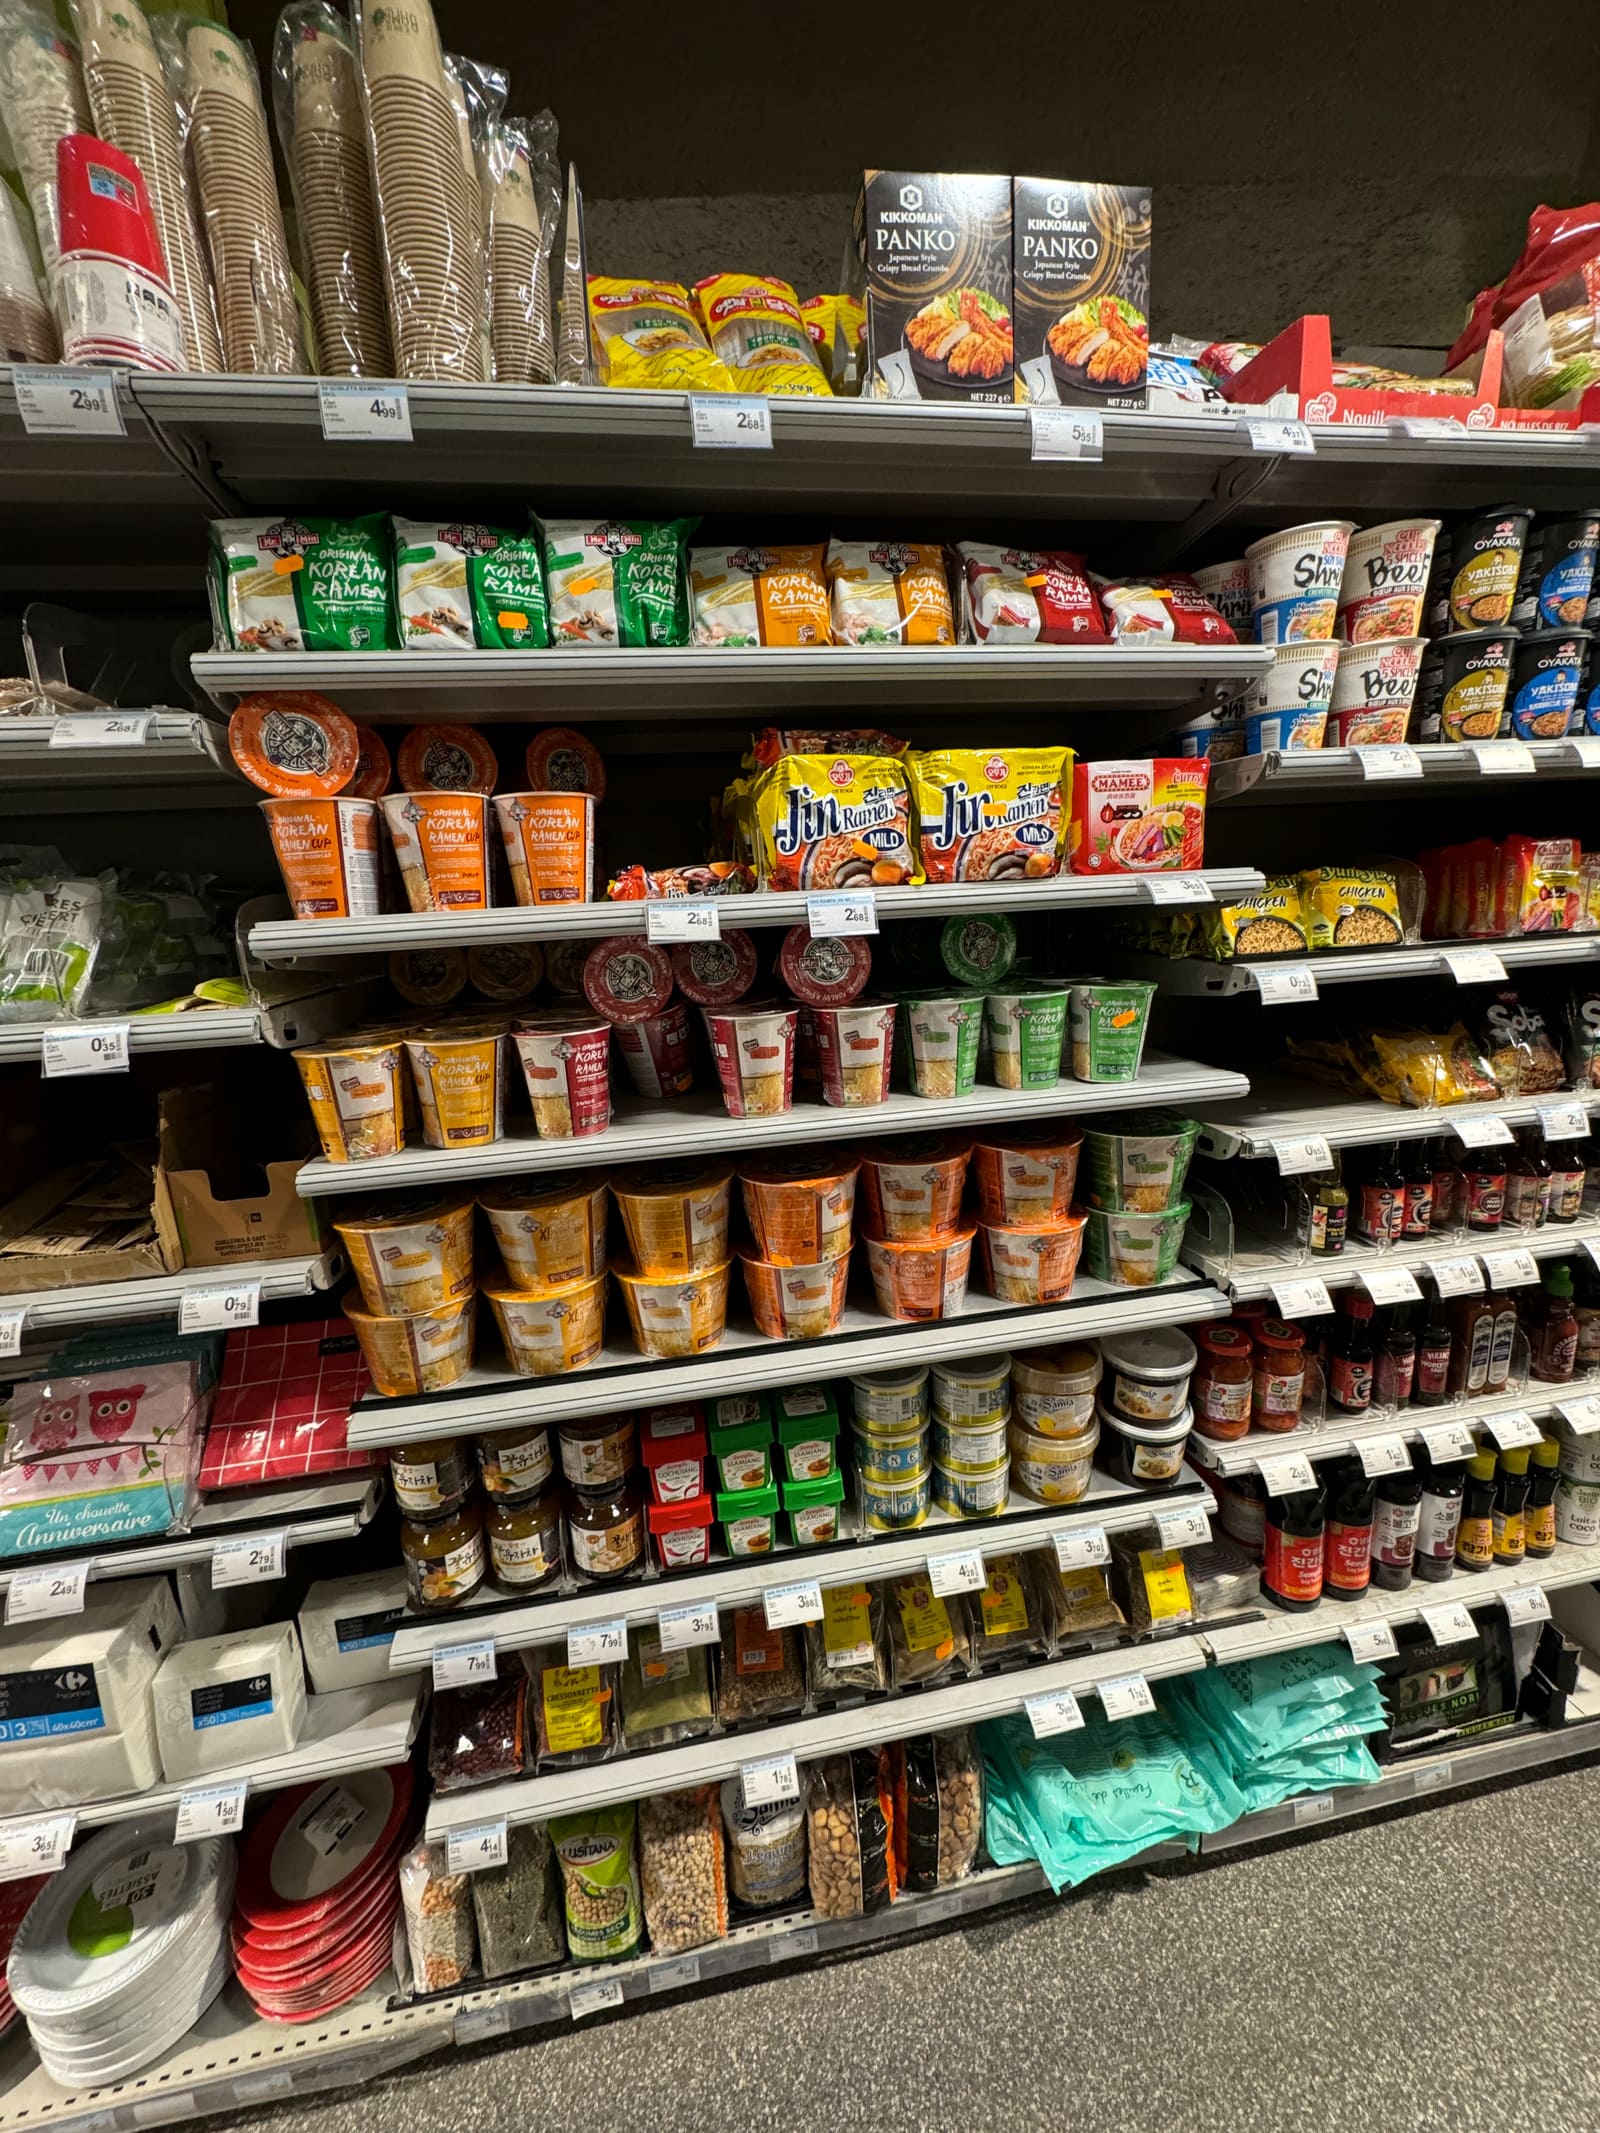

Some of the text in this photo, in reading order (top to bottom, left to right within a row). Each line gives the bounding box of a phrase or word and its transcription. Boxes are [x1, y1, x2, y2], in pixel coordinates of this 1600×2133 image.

[880, 211, 943, 224] KIKKOMAN
[1027, 218, 1087, 233] KIKKOMAN
[876, 229, 955, 251] PANKO
[1022, 236, 1098, 260] PANKO
[889, 253, 937, 263] Japanese Style
[1034, 260, 1063, 270] Japanese
[877, 264, 949, 273] Crispy Bread Crumbs
[1023, 271, 1091, 281] Crispy Bread Crumbs
[970, 393, 997, 403] NET 227
[1107, 398, 1133, 408] NET 227
[318, 549, 375, 562] ORIGINAL
[309, 561, 387, 582] KOREAN
[312, 581, 387, 600] RAMEN
[767, 576, 827, 597] KOREAN
[769, 591, 828, 608] RAMEN
[1099, 777, 1144, 789] MAMEE
[529, 815, 580, 830] KOREAN
[776, 785, 896, 853] Jin Ramen
[934, 783, 993, 848] Jin
[276, 823, 329, 838] KOREAN
[426, 817, 479, 831] KOREAN
[311, 837, 332, 849] CUP
[429, 831, 481, 844] RAMEN CUP
[531, 831, 580, 843] RAMEN CUP
[869, 832, 900, 848] MILD
[1023, 829, 1050, 844] MILD
[1338, 885, 1385, 899] CHICKEN
[1235, 896, 1287, 910] CHICKEN
[438, 1060, 490, 1076] KOREAN
[439, 1072, 491, 1086] RAMEN CUP
[1041, 1395, 1075, 1409] Samia
[1047, 1464, 1079, 1477] Samia
[46, 1502, 130, 1525] Un chouette
[1570, 1514, 1590, 1524] Lait
[16, 1512, 152, 1549] Anniversaire
[1450, 1693, 1480, 1708] NORI
[197, 1712, 227, 1728] x50 3
[14, 1723, 26, 1738] 3
[563, 1839, 616, 1859] LUSITANA
